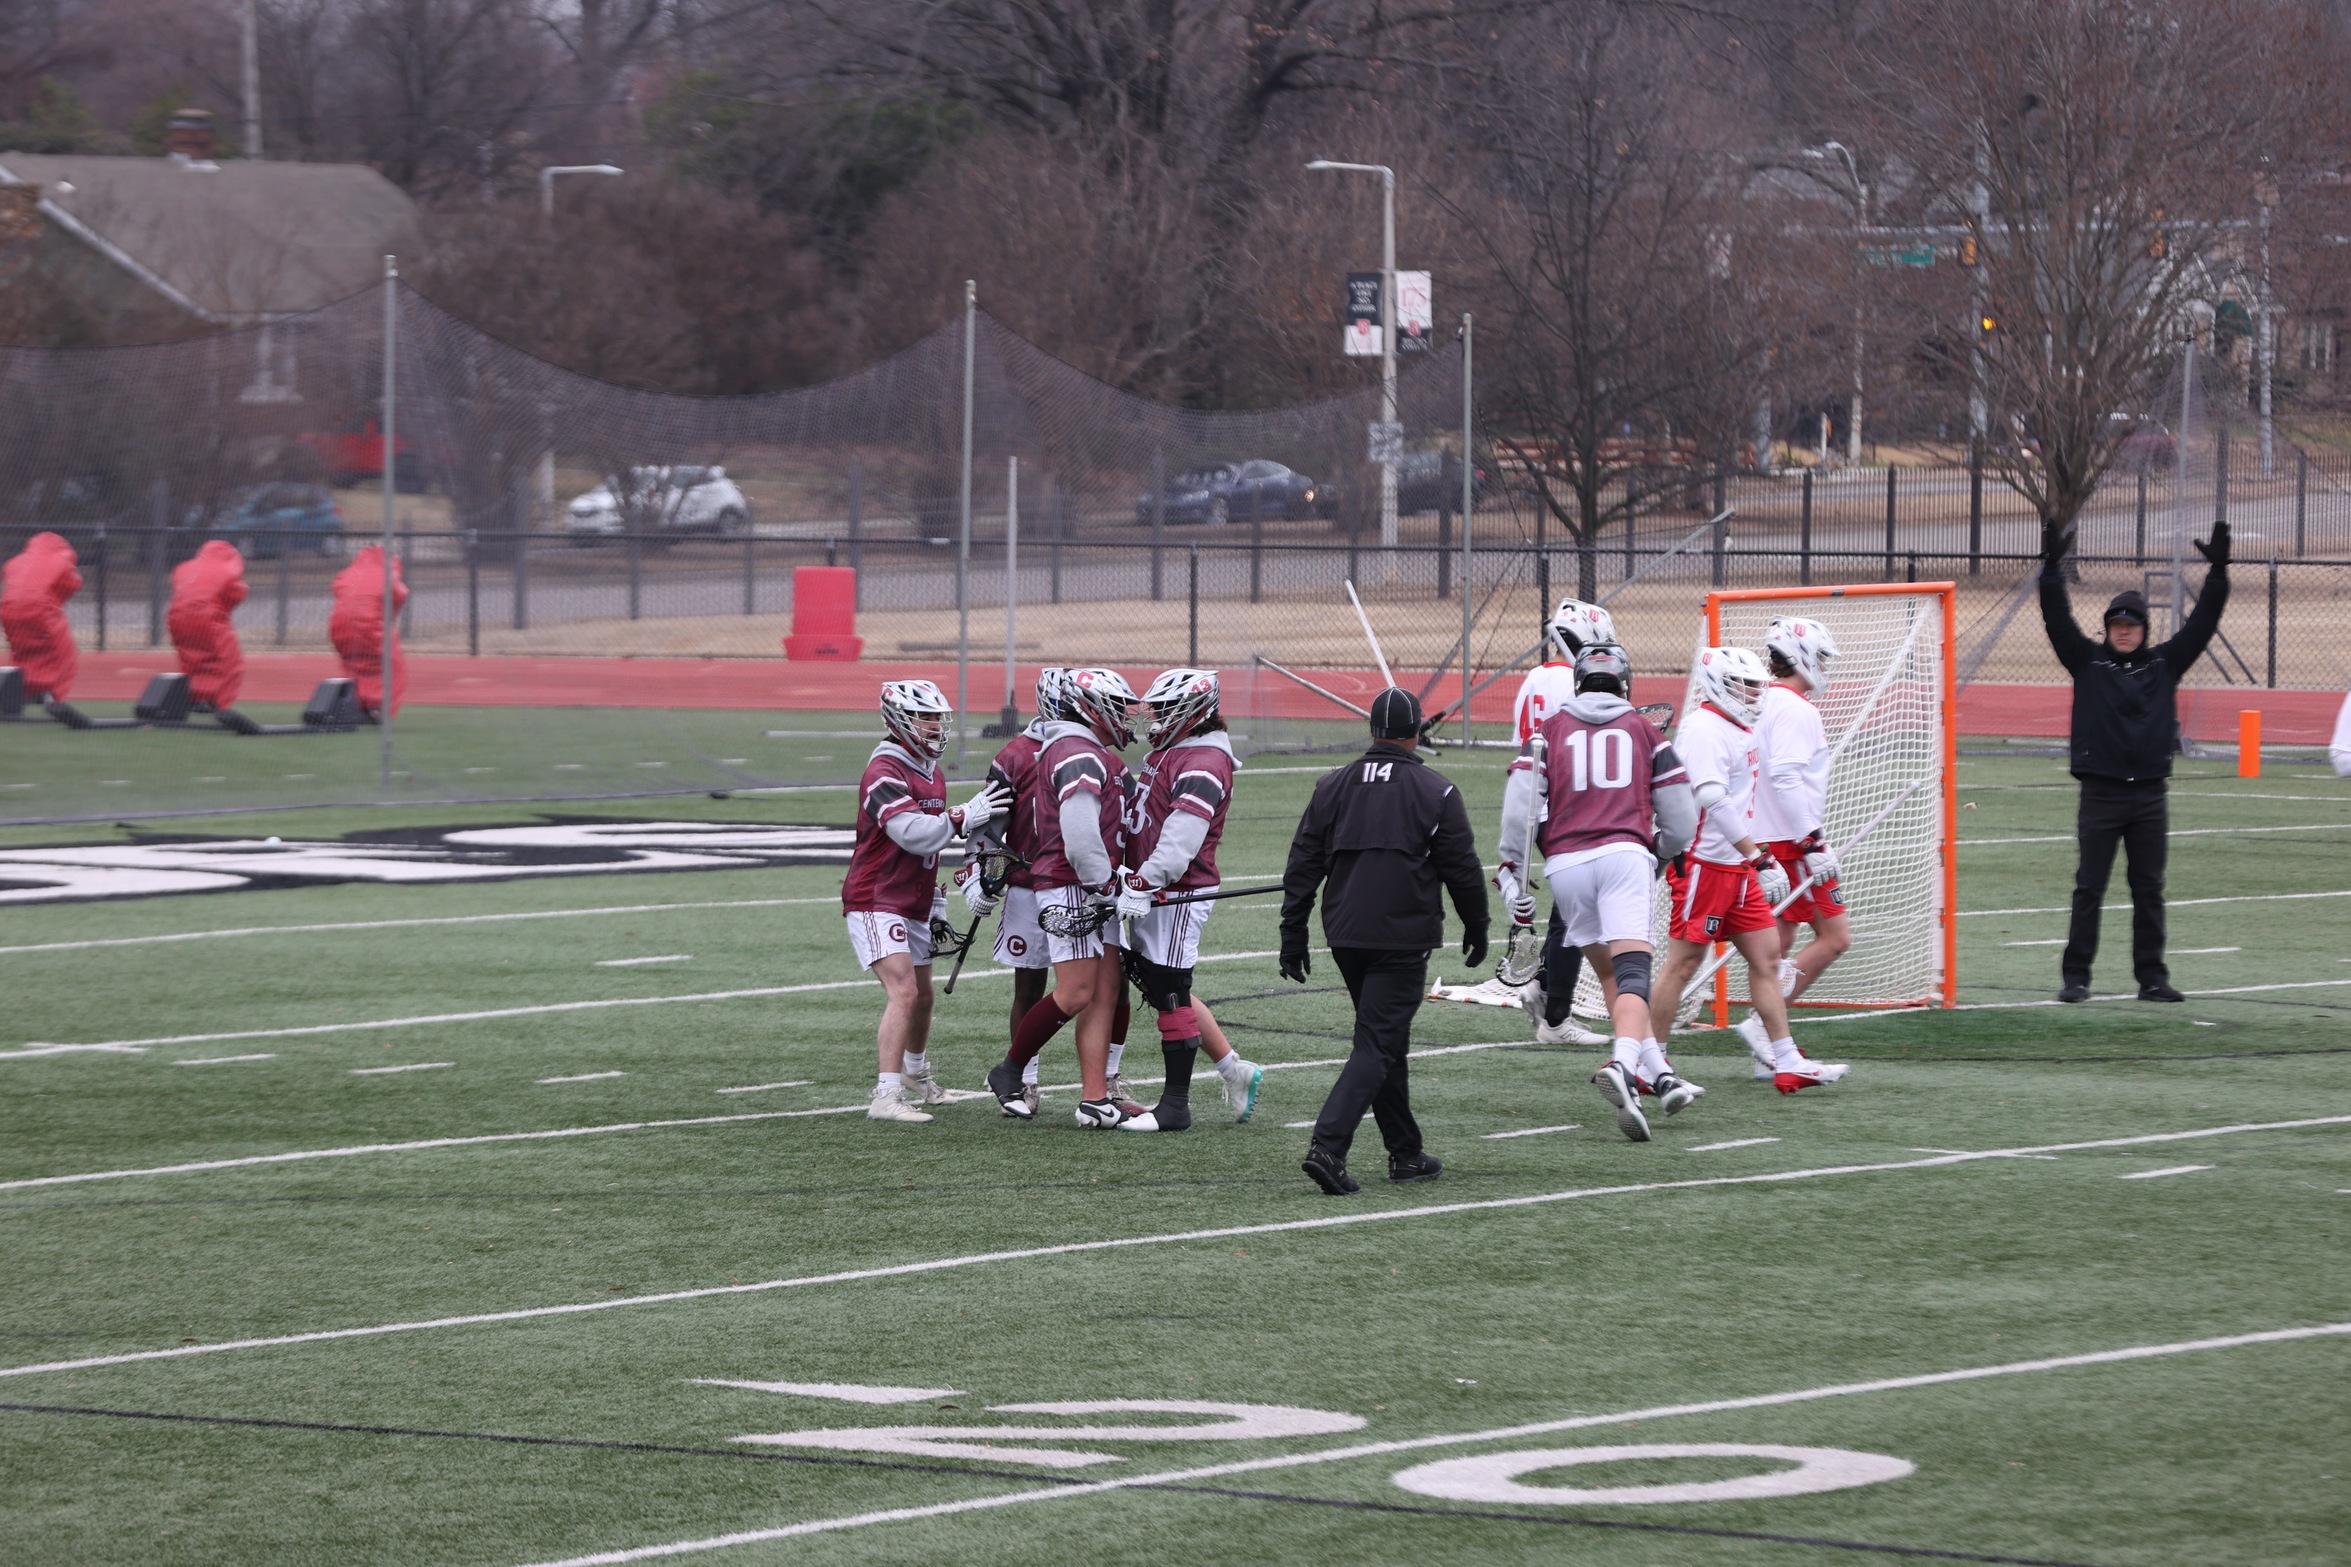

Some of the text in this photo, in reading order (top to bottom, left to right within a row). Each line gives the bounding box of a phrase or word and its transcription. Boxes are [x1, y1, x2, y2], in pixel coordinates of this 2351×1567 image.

[1076, 671, 1094, 688] C
[1565, 728, 1633, 792] 10
[1363, 762, 1394, 782] 114
[1009, 937, 1026, 954] C
